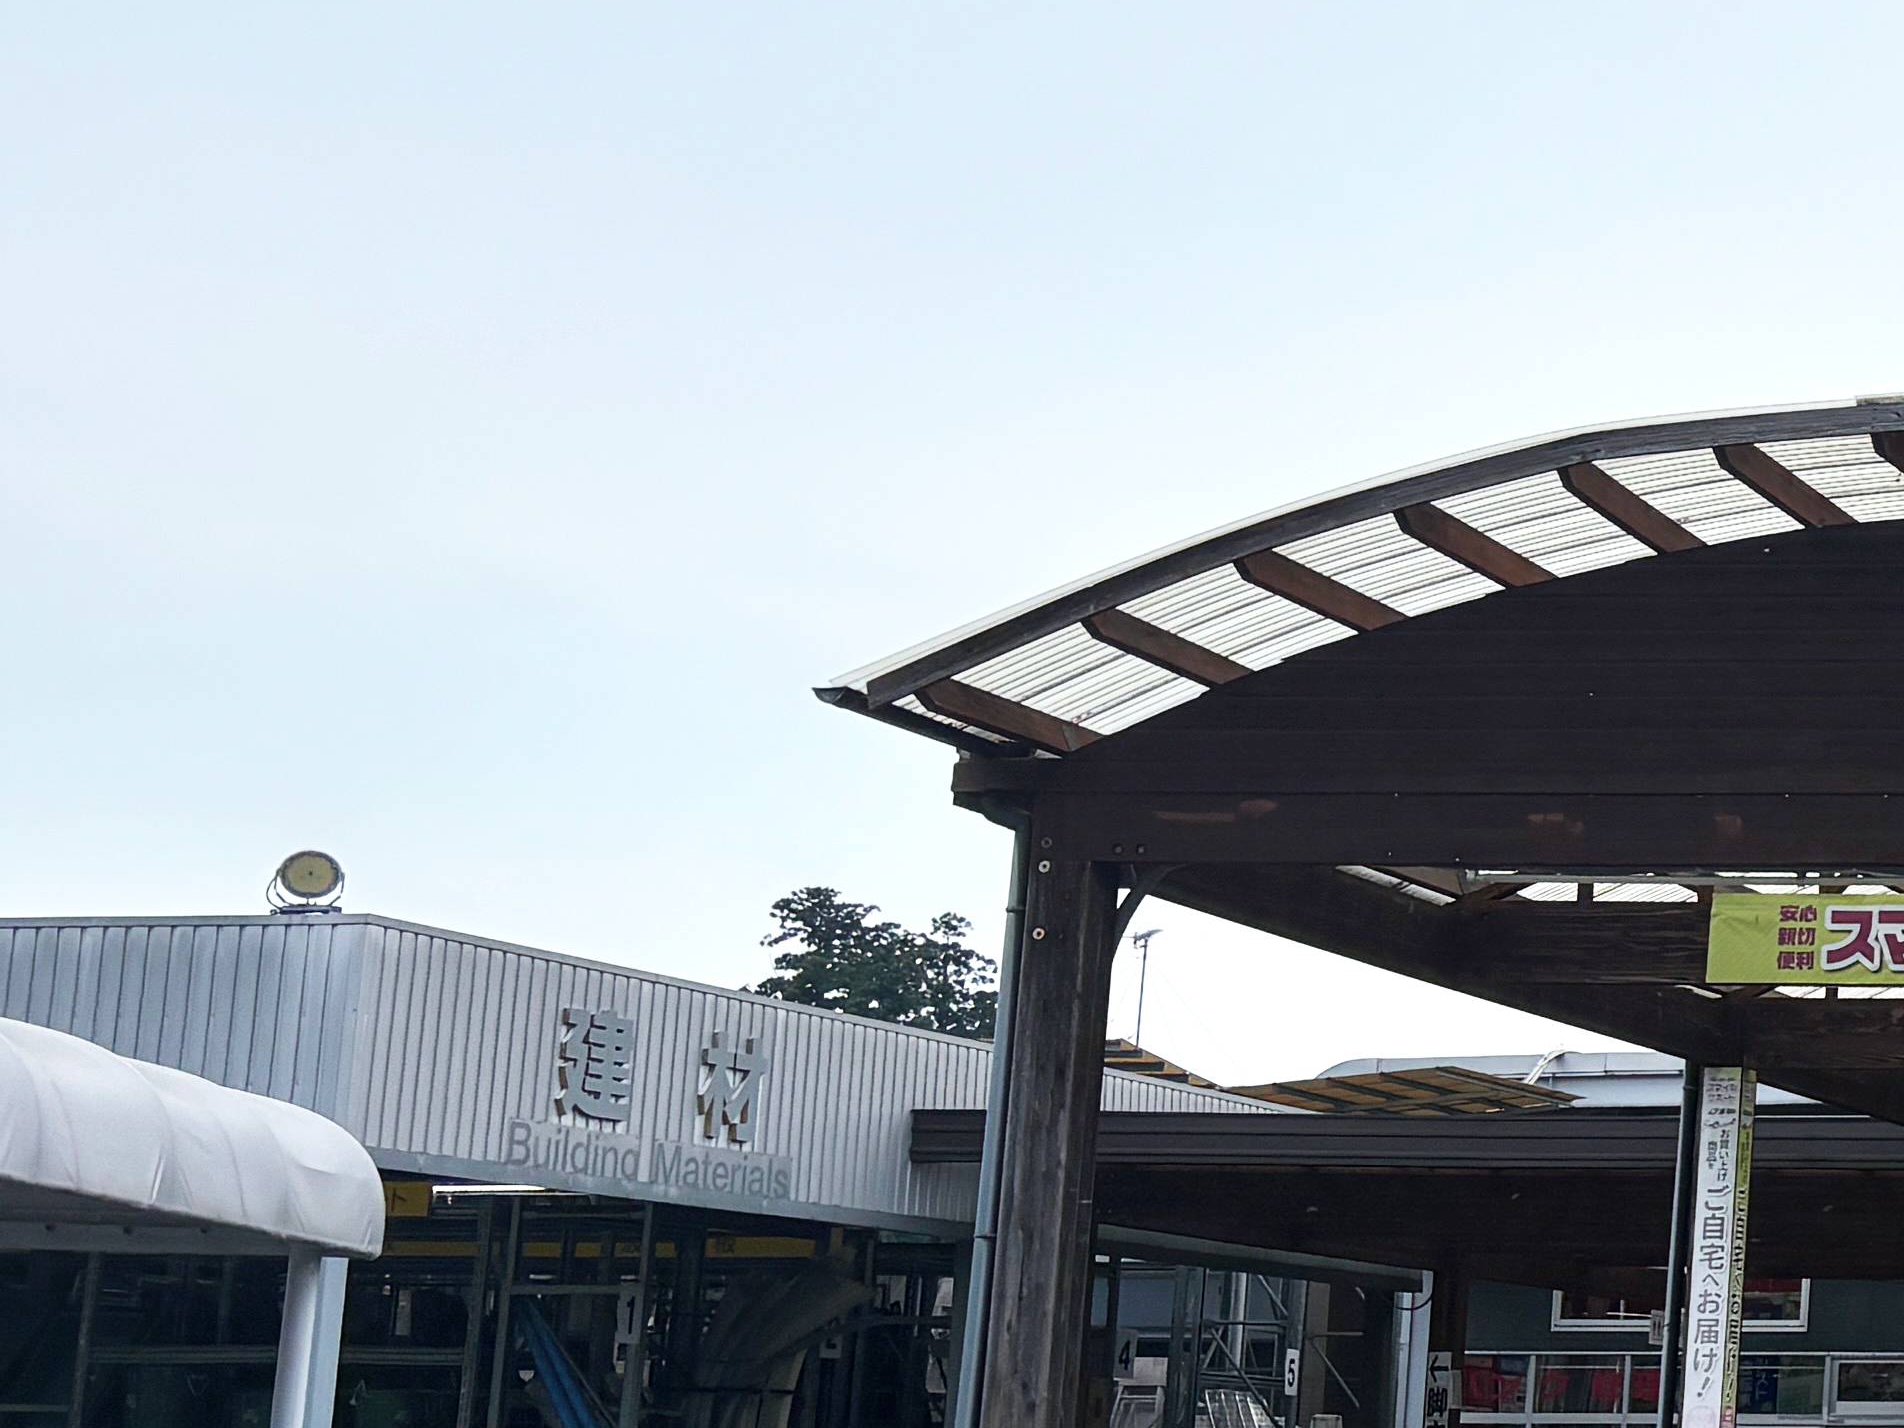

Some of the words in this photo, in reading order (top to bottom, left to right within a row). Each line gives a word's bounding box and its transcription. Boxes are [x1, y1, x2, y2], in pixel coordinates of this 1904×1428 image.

[555, 1007, 769, 1146] 建材
[508, 1122, 640, 1180] Building
[653, 1142, 791, 1200] Materials
[1693, 1184, 1730, 1398] ご自宅へお届け!
[1286, 1357, 1296, 1388] 5
